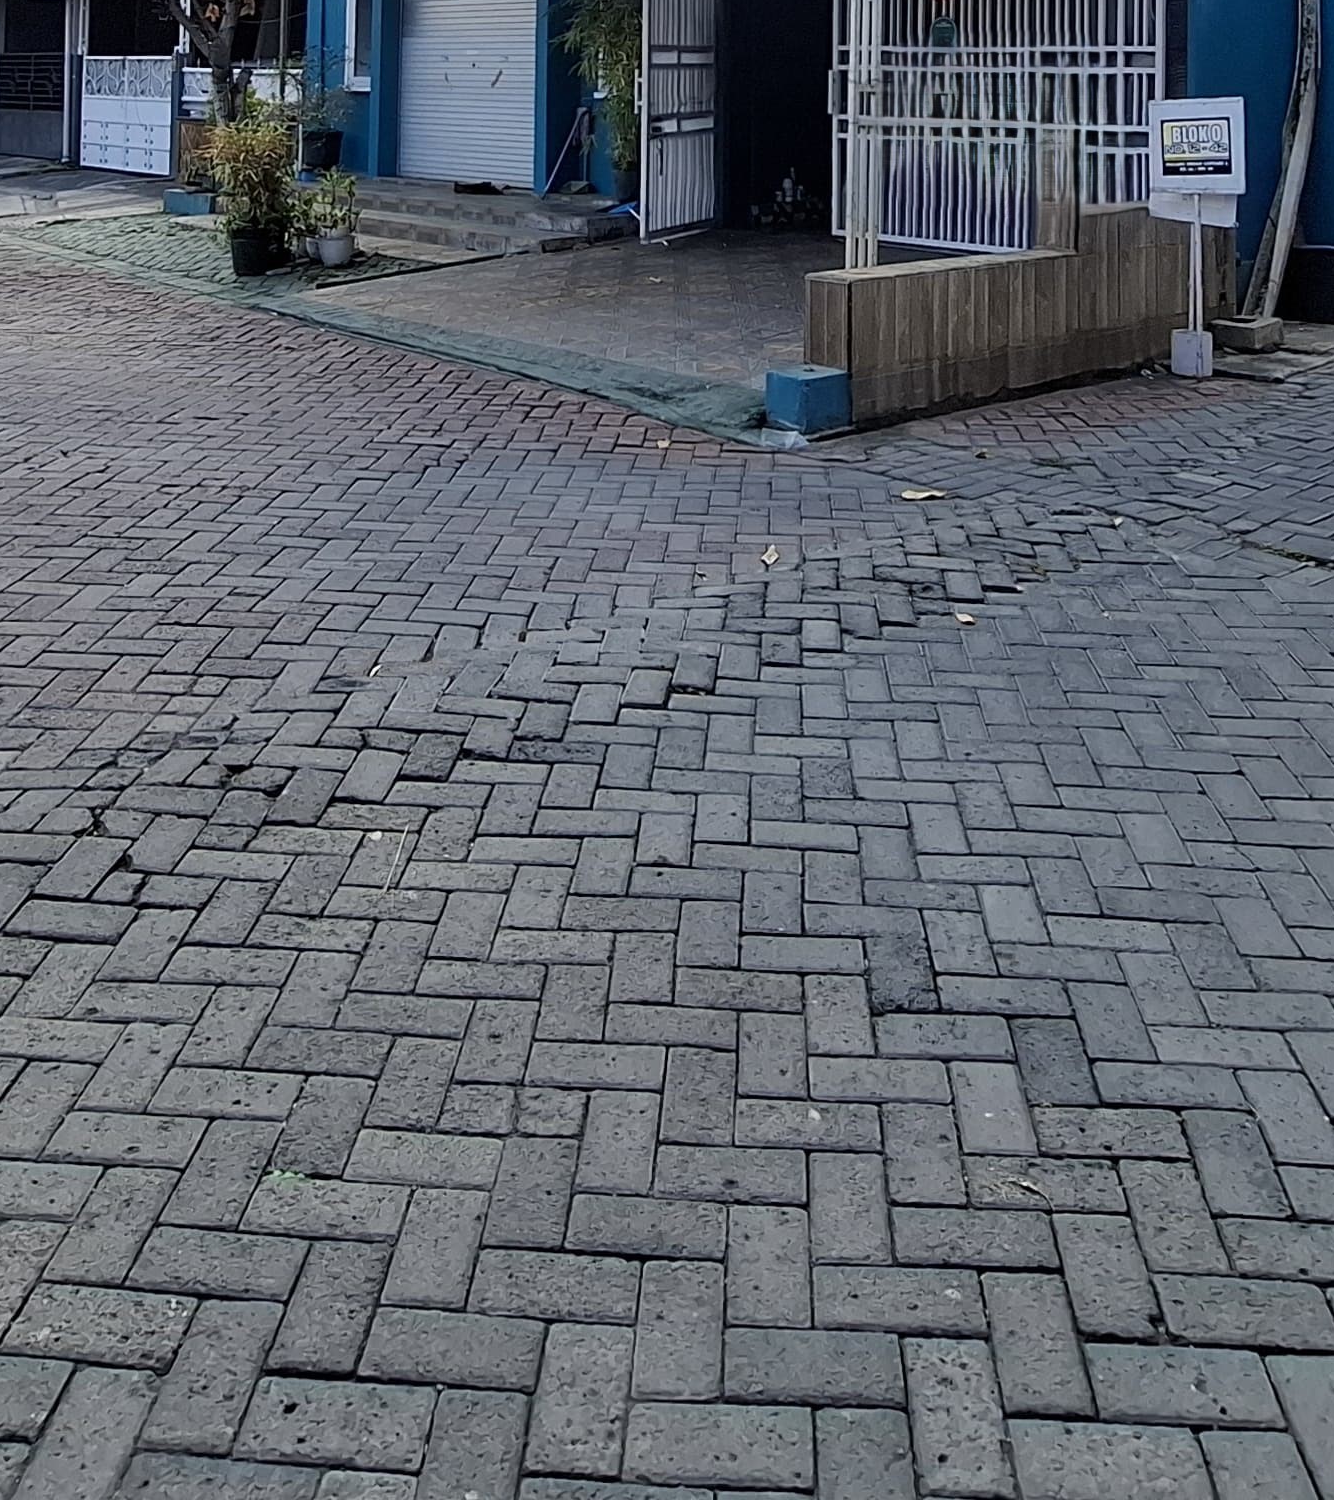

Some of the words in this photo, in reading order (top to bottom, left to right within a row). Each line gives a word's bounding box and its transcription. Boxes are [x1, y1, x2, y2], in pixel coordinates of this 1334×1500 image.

[1171, 124, 1210, 144] BLOK
[1164, 144, 1186, 155] NO.
[1188, 143, 1201, 154] 12
[1209, 142, 1228, 154] 42
